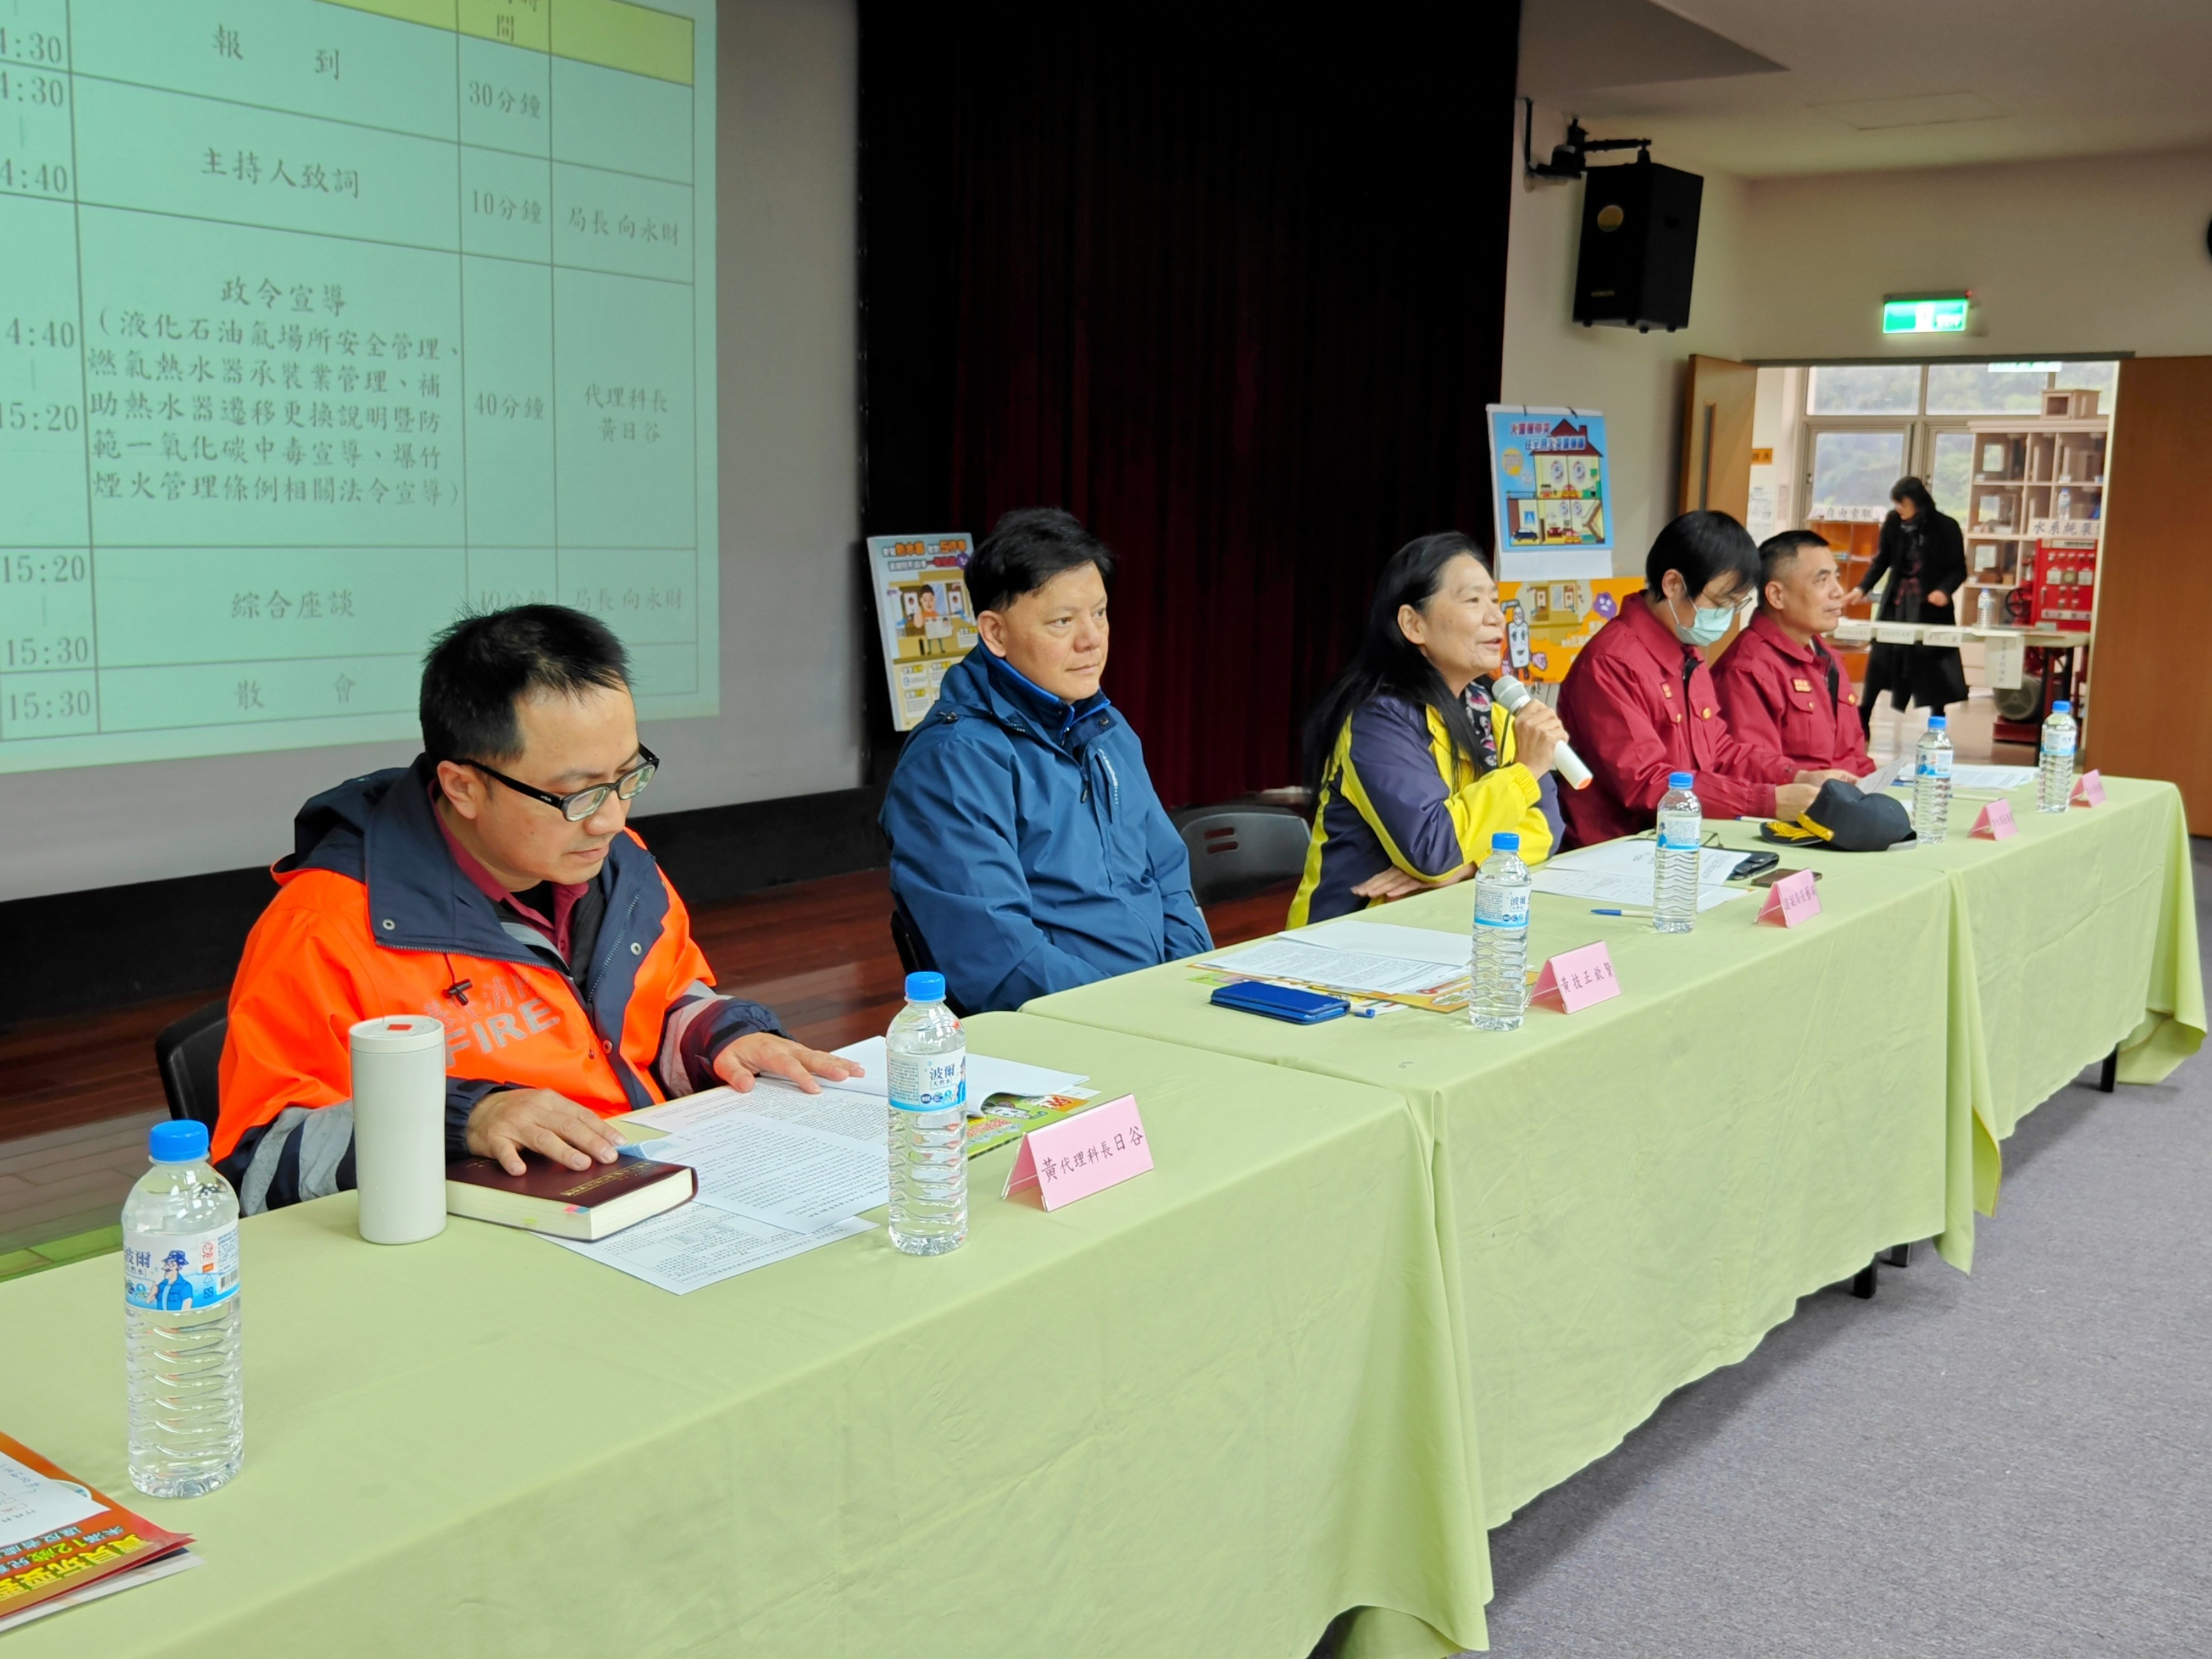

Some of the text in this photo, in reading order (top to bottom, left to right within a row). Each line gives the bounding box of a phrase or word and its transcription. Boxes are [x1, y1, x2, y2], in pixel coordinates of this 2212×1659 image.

[213, 24, 340, 81] 報 到
[469, 81, 541, 119] 30分鐘
[201, 147, 359, 199] 主持人致詞
[473, 190, 541, 223] 10分鐘
[221, 276, 346, 317] 政令宣導
[474, 391, 546, 421] 40分鐘
[583, 383, 668, 414] 代理科長
[4, 556, 85, 583] 15:20
[232, 589, 354, 619] 綜合座談
[8, 636, 88, 666] 15:30
[11, 690, 91, 721] 15:30
[446, 996, 561, 1068] FIRE
[929, 1062, 955, 1080] 波爾
[1041, 1125, 1143, 1183] 黃代理科長日谷
